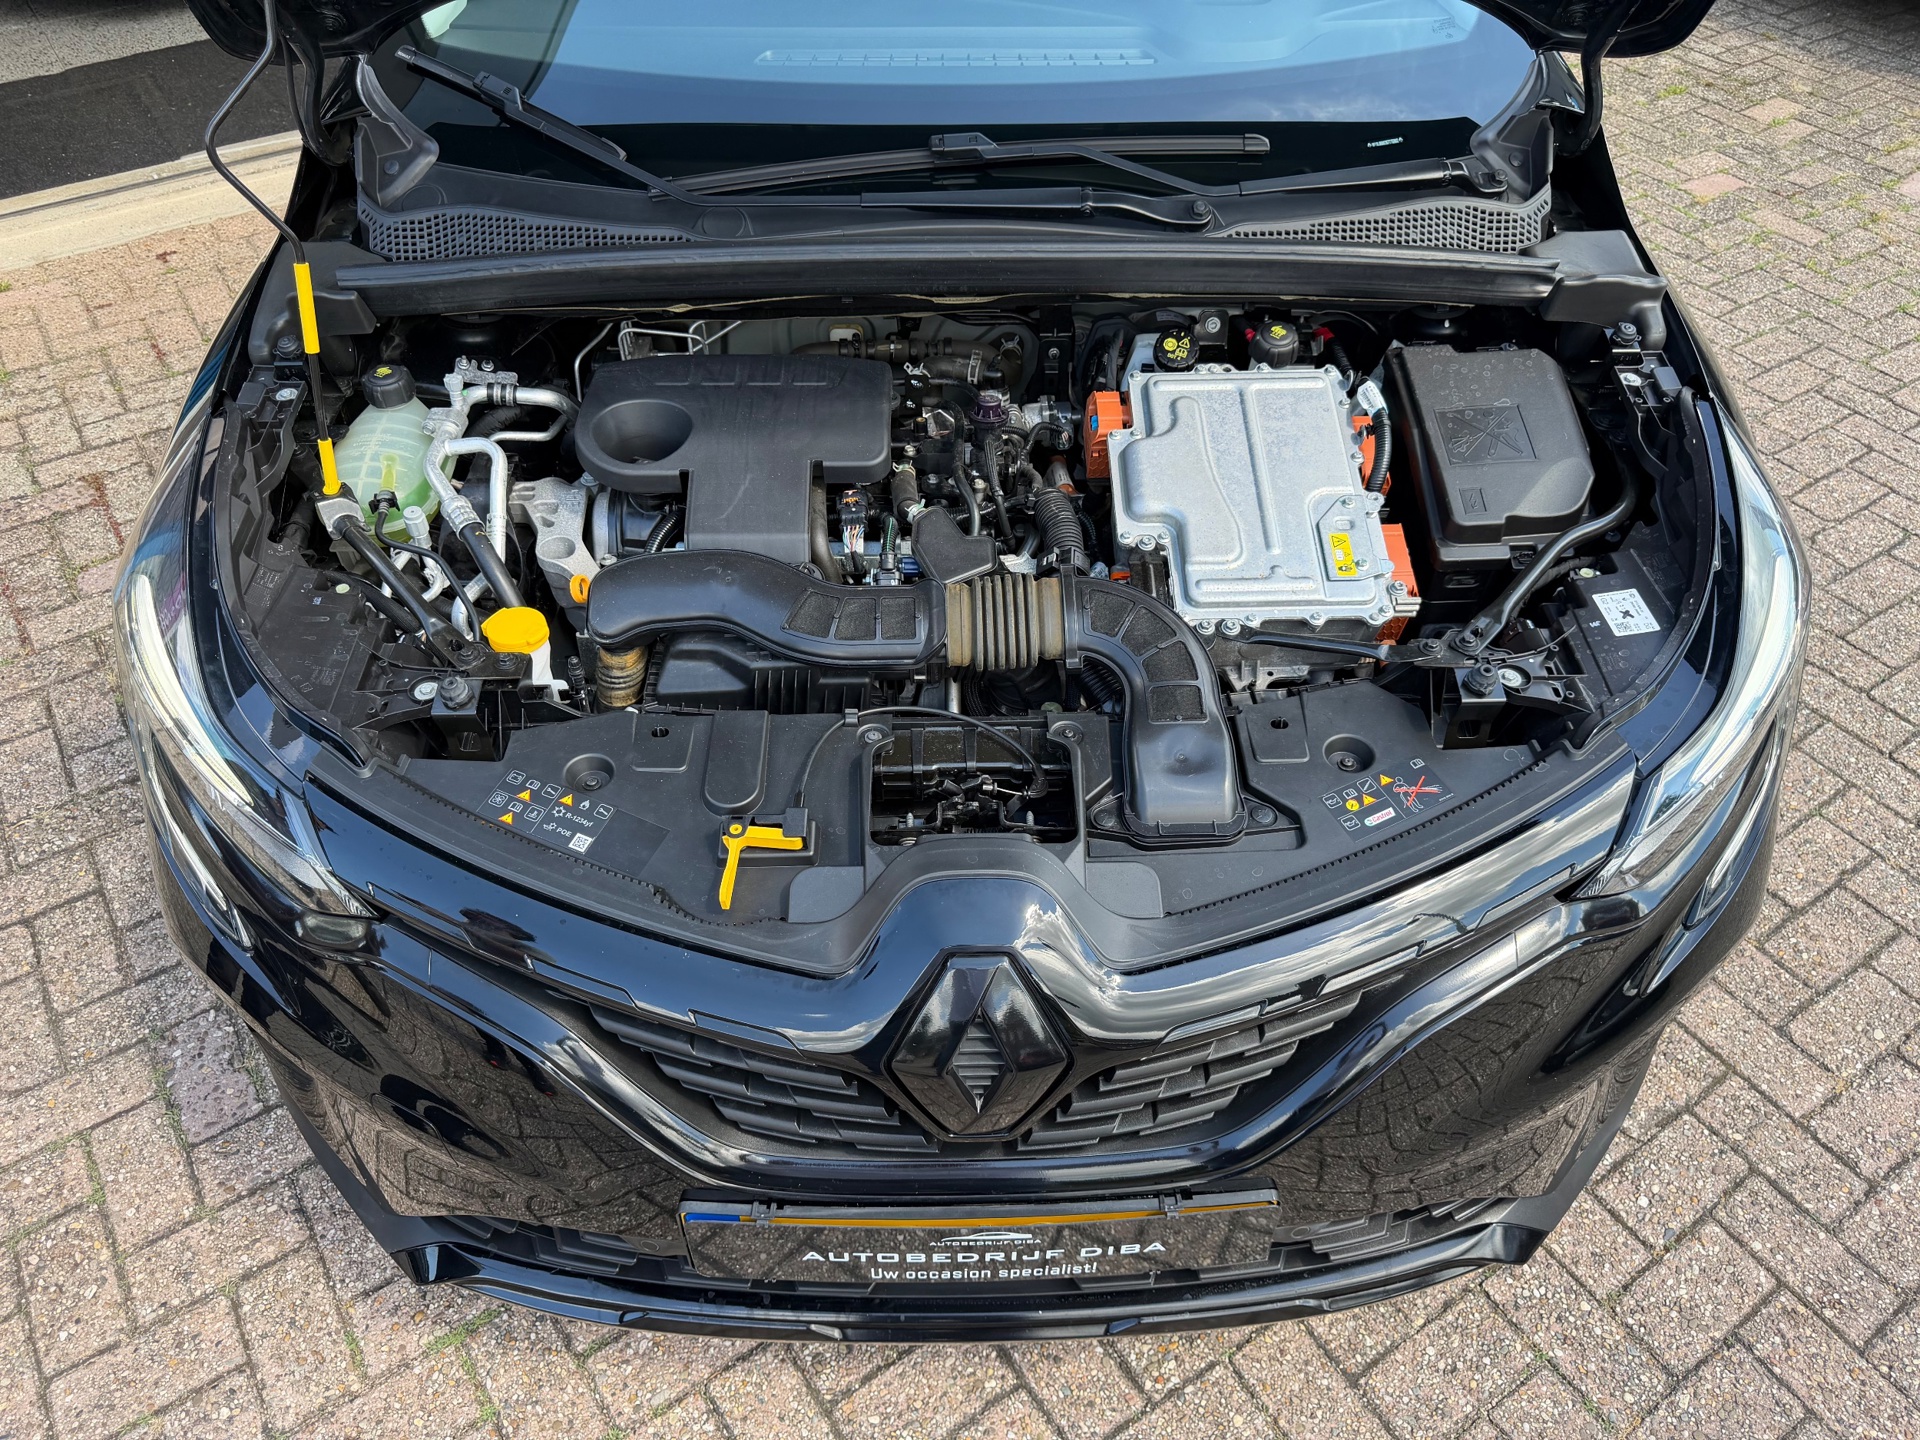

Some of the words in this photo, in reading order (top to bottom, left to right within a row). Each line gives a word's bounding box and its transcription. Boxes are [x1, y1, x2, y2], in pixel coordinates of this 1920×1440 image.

[565, 812, 593, 827] R-1234yf
[556, 827, 572, 837] POE
[802, 1248, 1065, 1263] AUTOBEDRIJF
[1080, 1242, 1167, 1257] DIBA
[871, 1267, 899, 1279] Uw
[906, 1268, 991, 1279] occasion
[998, 1262, 1097, 1279] specialist!
